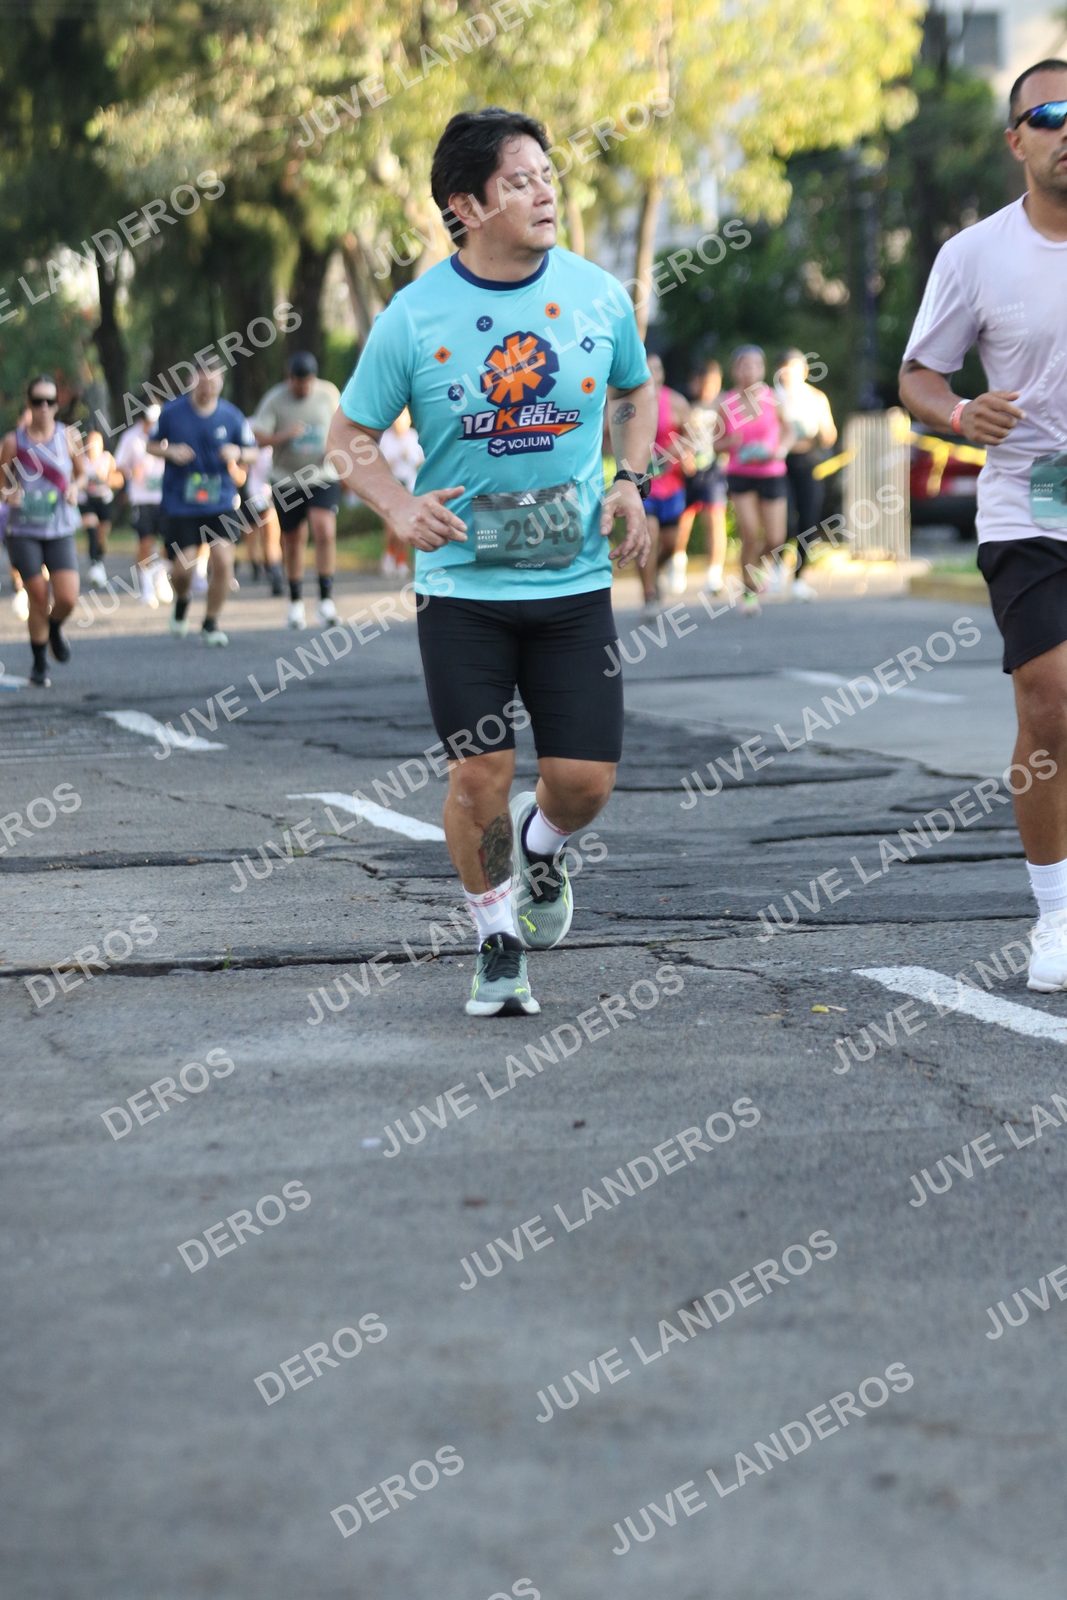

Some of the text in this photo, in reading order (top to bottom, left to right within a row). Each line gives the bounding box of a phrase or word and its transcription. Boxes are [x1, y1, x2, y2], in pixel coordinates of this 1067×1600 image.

[522, 403, 557, 415] DEL
[463, 407, 521, 434] 10K
[519, 411, 578, 426] GOLFO
[508, 436, 551, 449] VOLIUM
